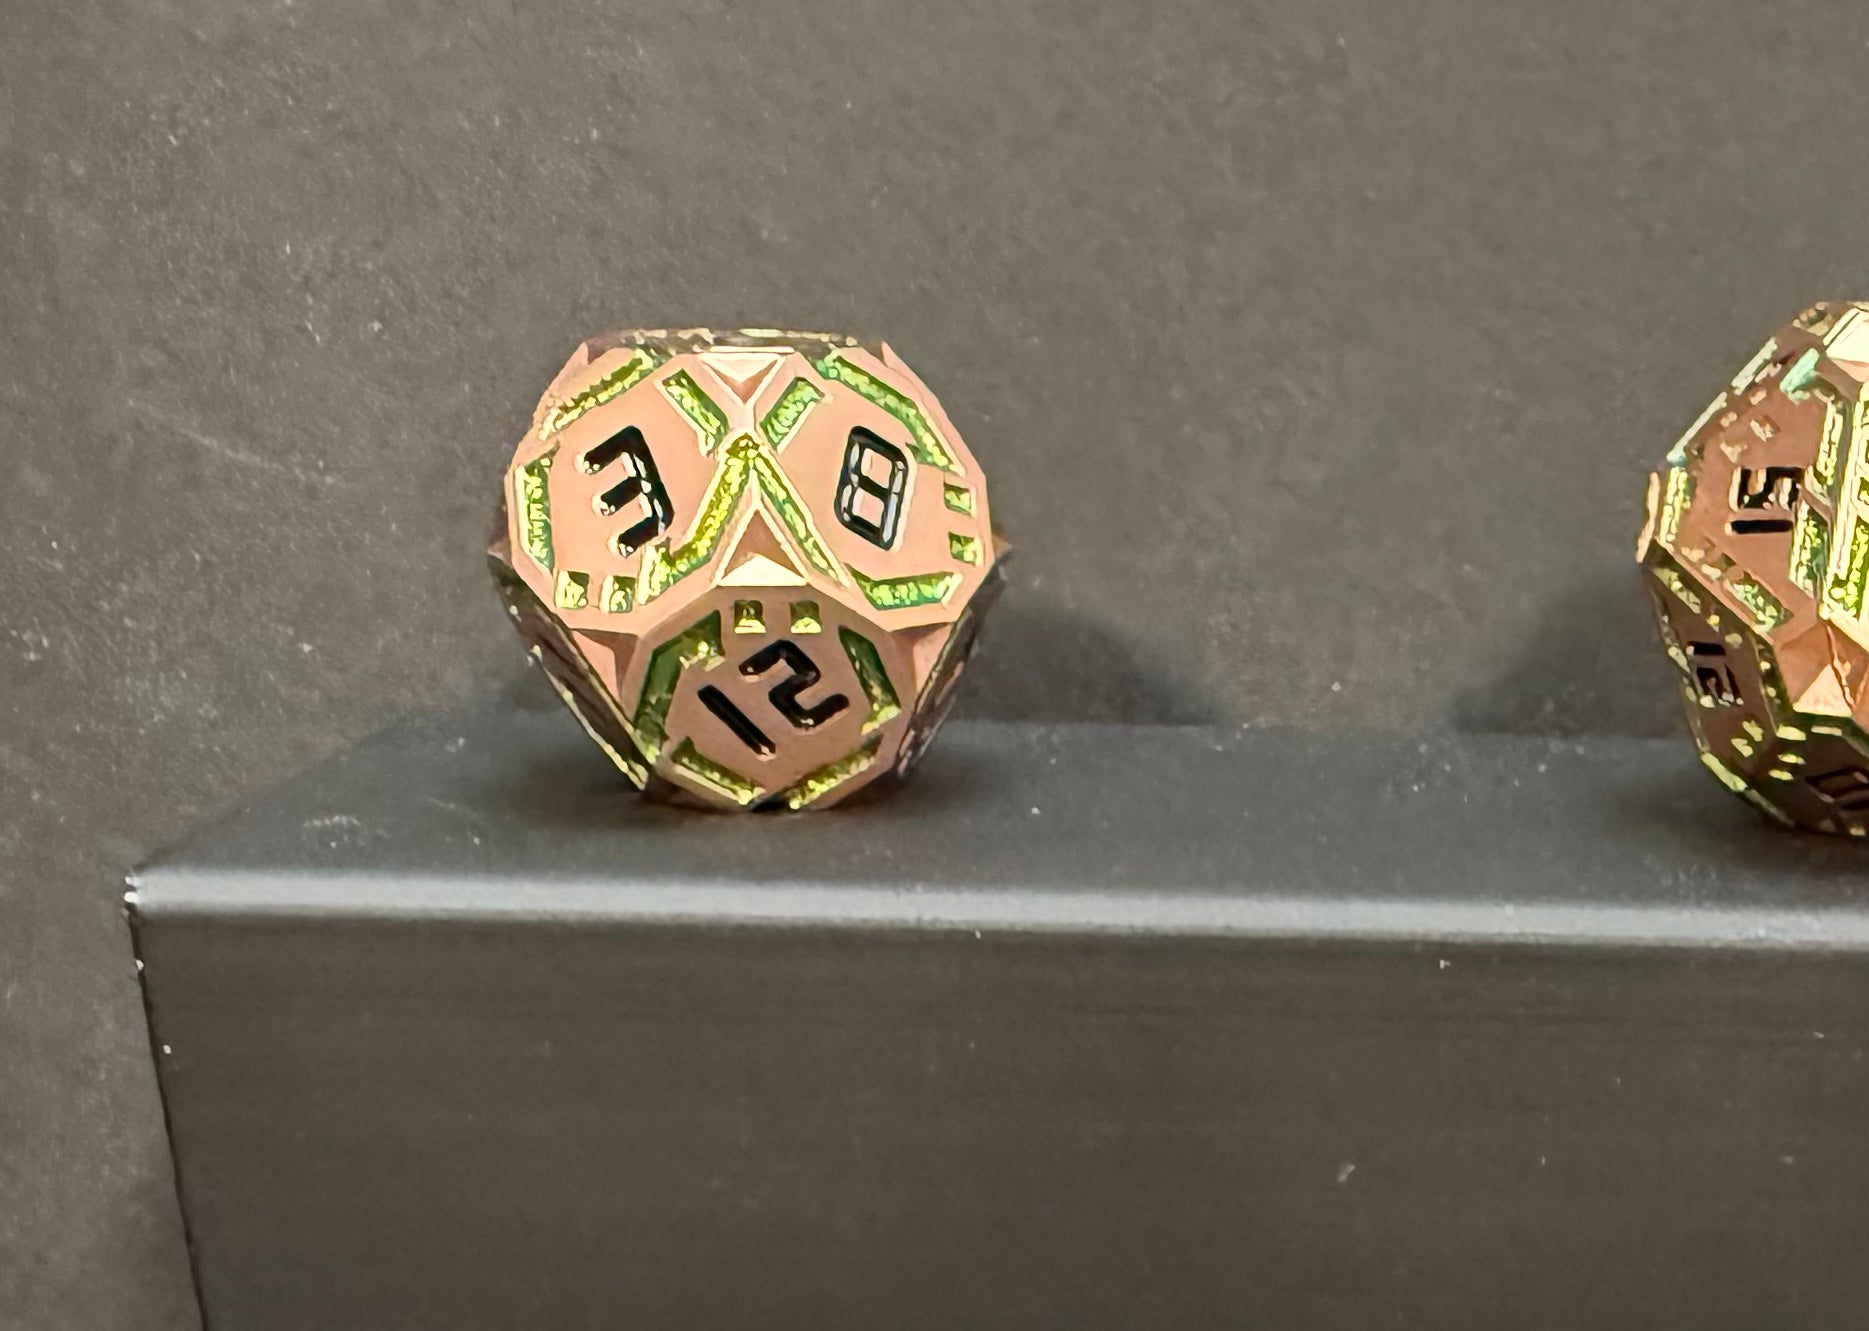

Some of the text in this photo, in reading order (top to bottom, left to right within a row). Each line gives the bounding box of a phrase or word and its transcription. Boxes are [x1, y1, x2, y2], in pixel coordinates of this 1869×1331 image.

[577, 424, 674, 559] 3
[834, 424, 913, 552] 8
[1724, 466, 1803, 536] 15
[696, 639, 850, 760] 12
